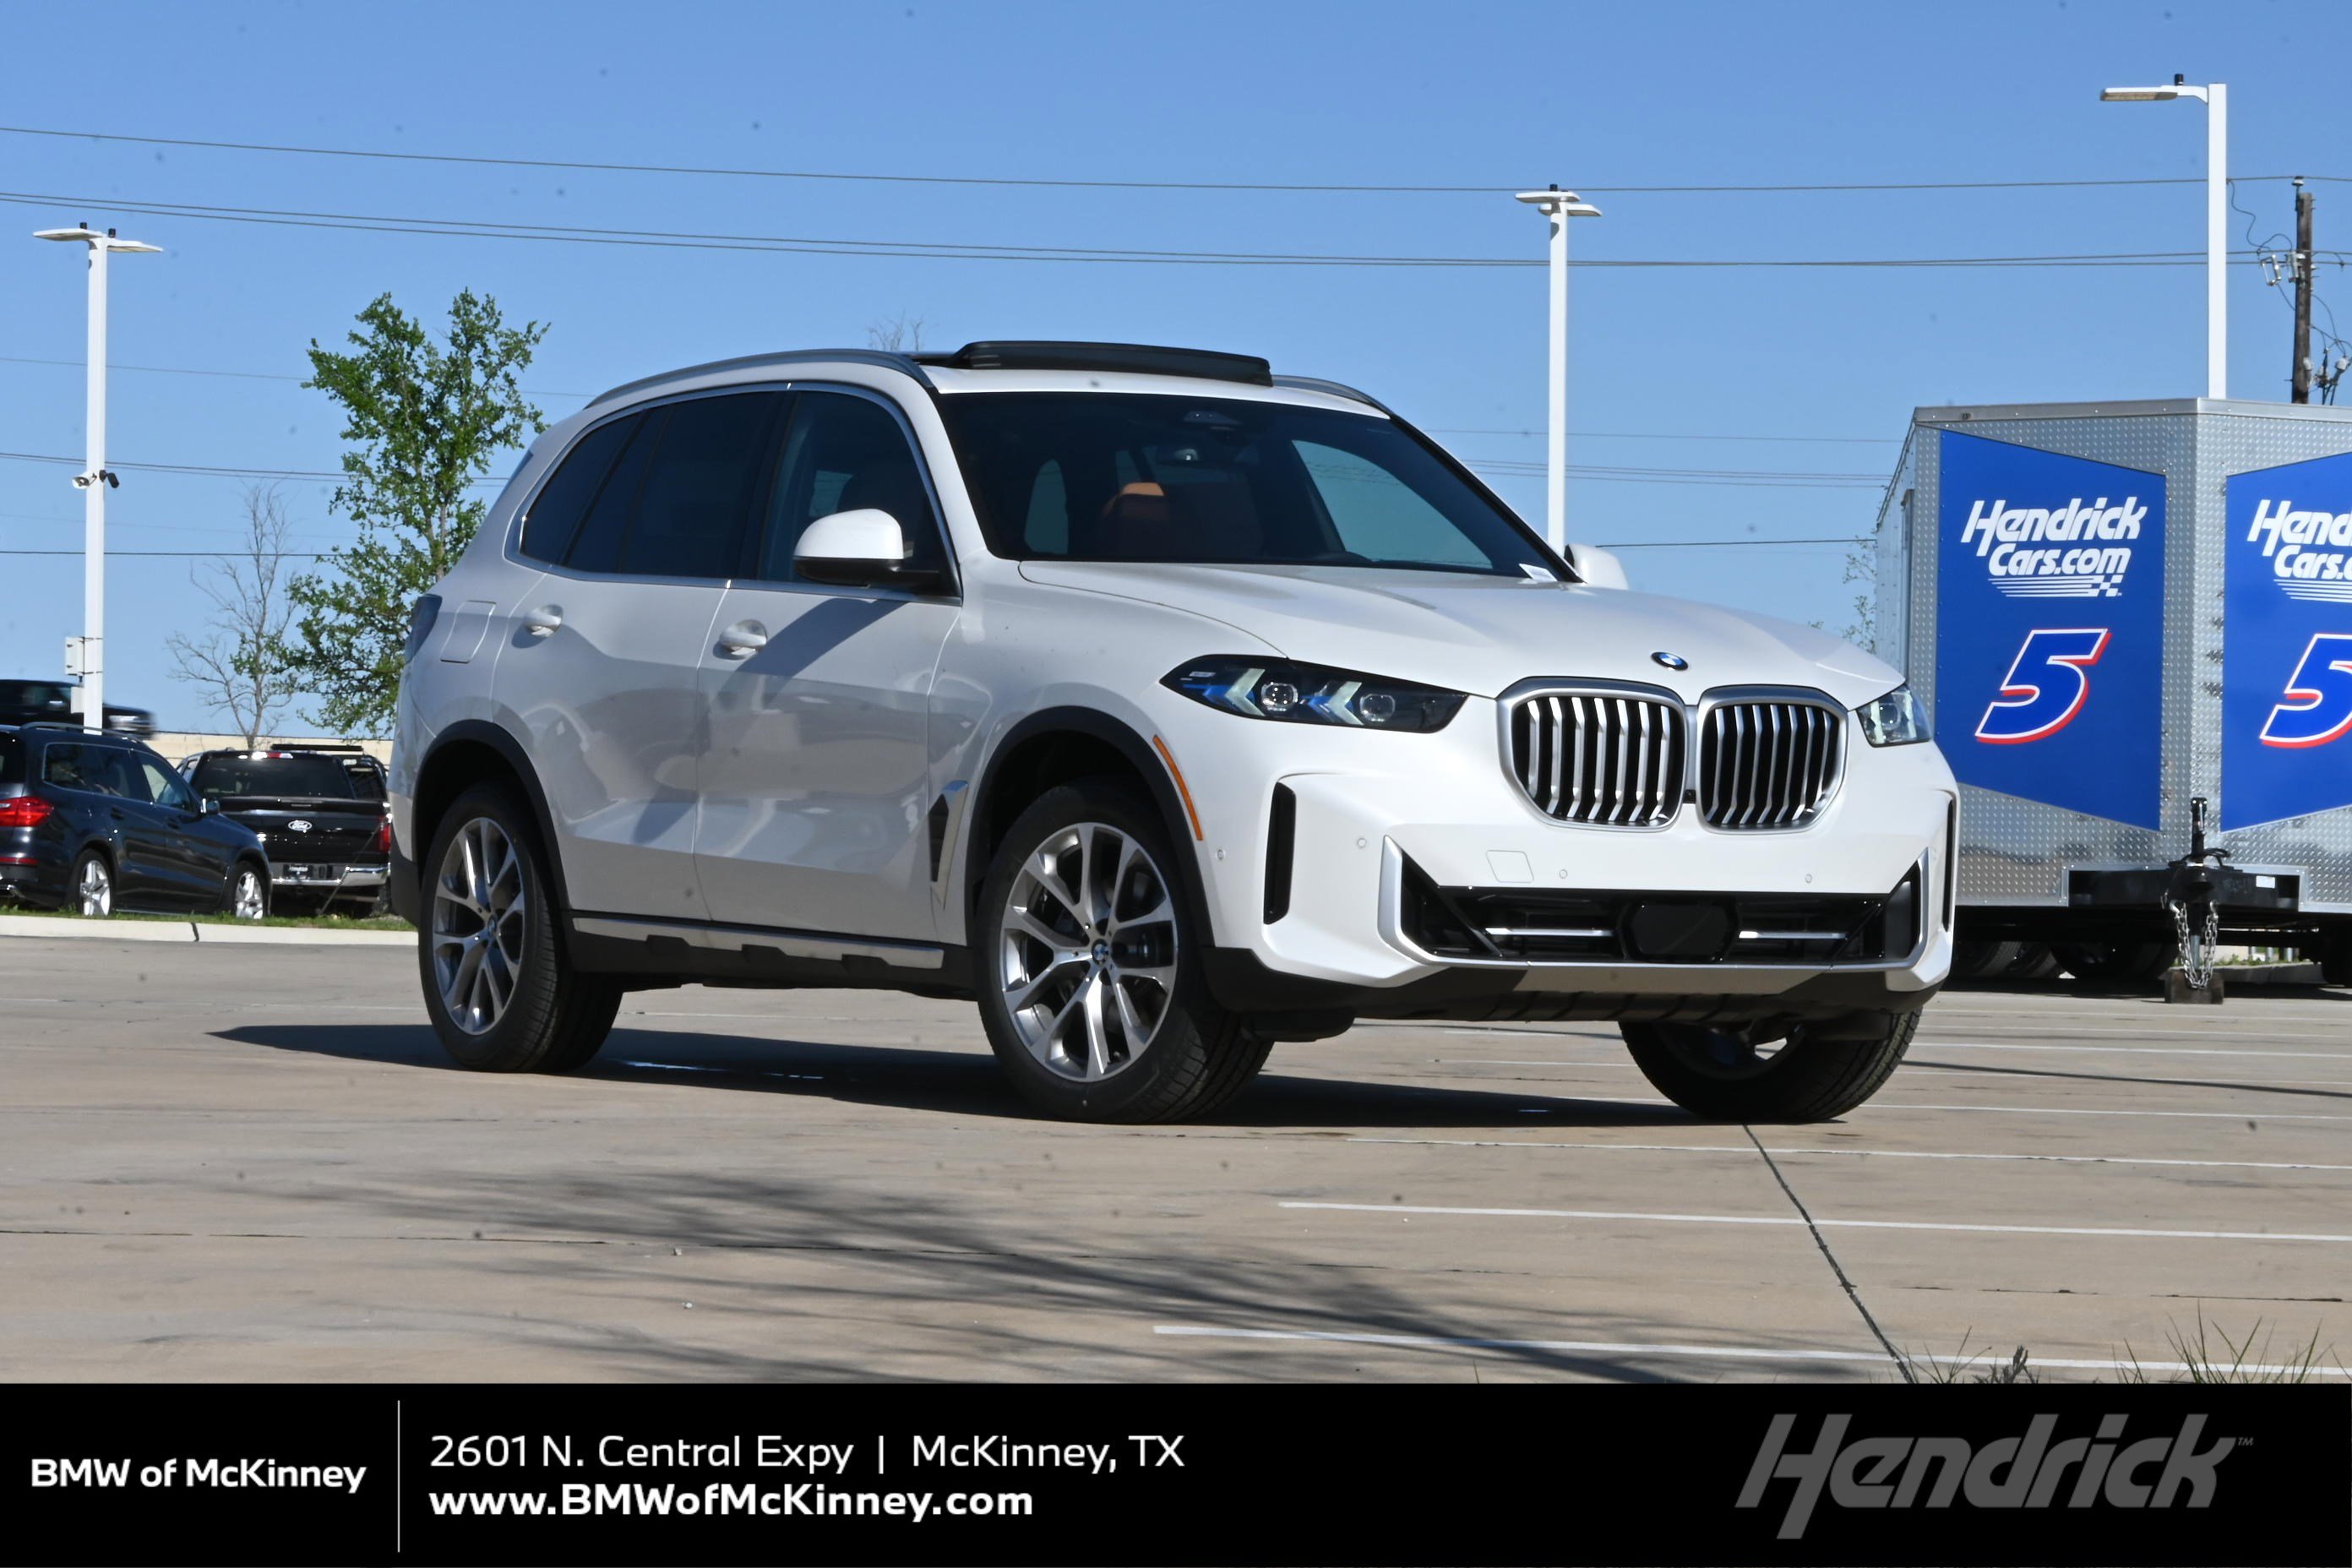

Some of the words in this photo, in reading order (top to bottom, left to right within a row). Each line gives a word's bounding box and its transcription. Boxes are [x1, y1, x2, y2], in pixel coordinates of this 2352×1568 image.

[1960, 496, 2148, 557] Hendrick
[1988, 542, 2132, 576] Cars.com
[1975, 628, 2112, 743] 5
